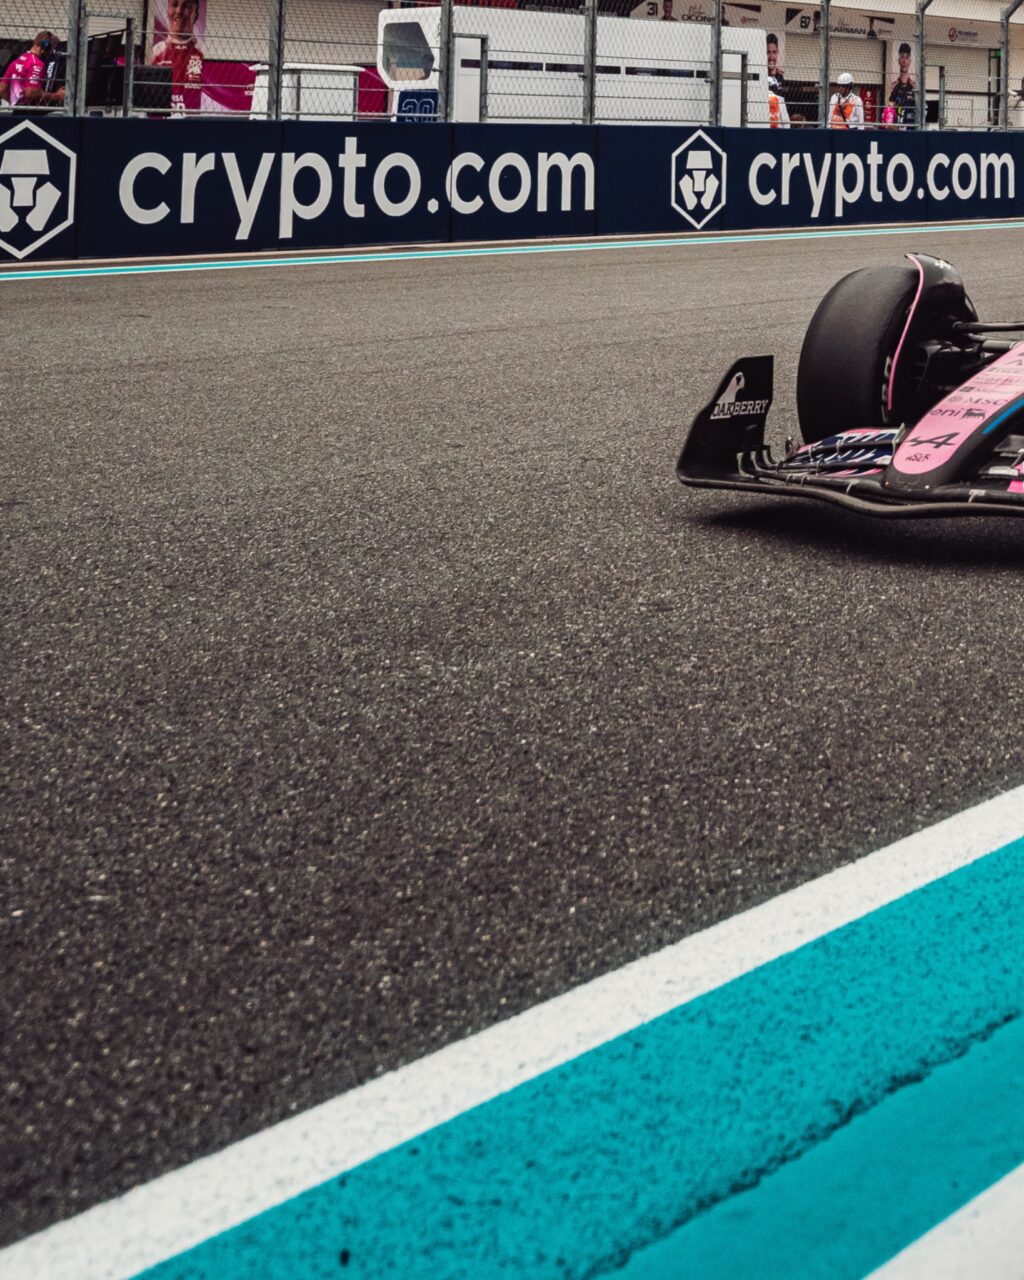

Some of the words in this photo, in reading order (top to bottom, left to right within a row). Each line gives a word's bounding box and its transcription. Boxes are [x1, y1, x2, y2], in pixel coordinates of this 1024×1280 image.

[646, 2, 658, 16] 31
[119, 137, 595, 241] crypto.com
[748, 140, 1015, 219] crypto.com
[710, 399, 769, 418] OAKBERRY
